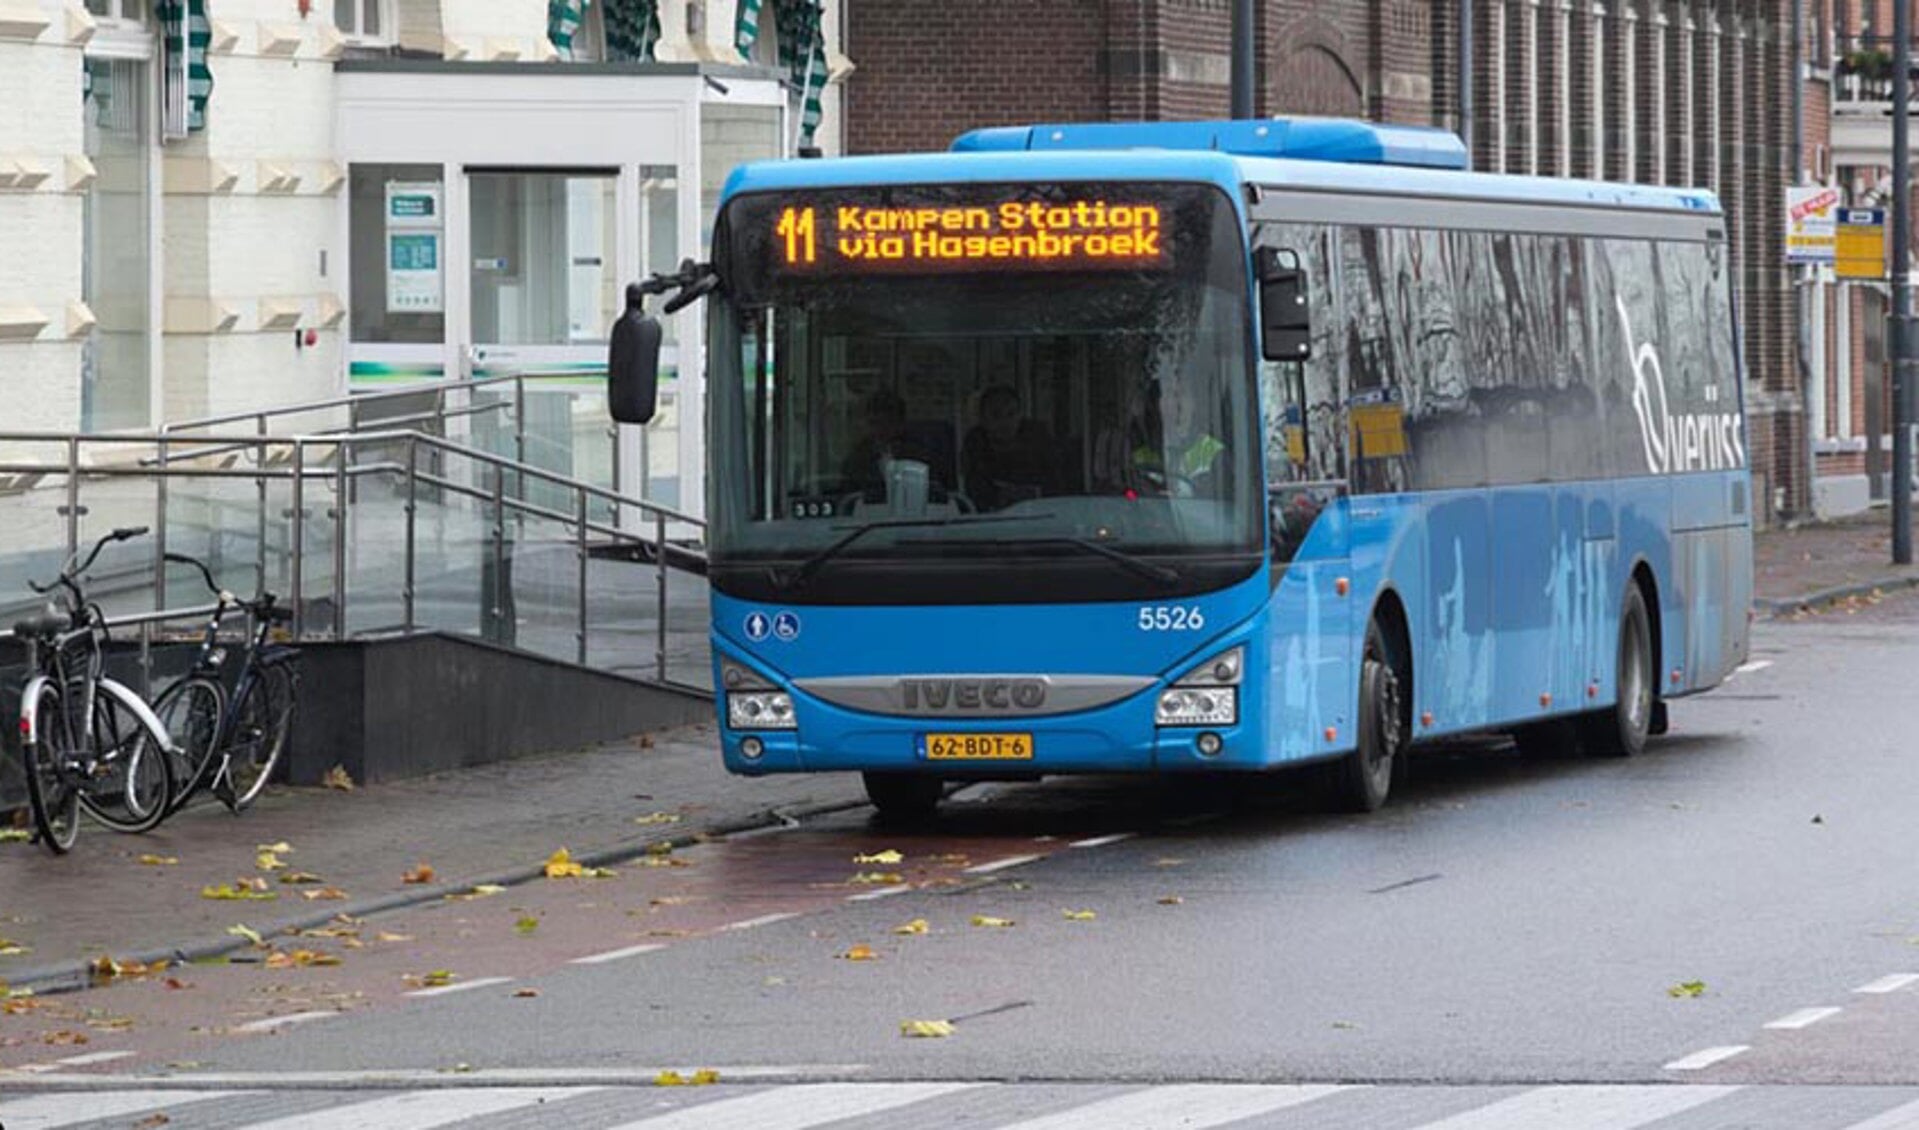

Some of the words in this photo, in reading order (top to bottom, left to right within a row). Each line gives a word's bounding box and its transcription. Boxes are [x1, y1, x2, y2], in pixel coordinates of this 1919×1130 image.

[838, 207, 990, 230] Kampen
[1000, 202, 1159, 229] Station
[778, 208, 815, 262] 11
[838, 232, 904, 258] via
[912, 229, 1159, 257] Hagenbroek
[1139, 606, 1204, 631] 5526
[903, 679, 1046, 709] IVECO
[931, 737, 1026, 756] 62-BDT-6
